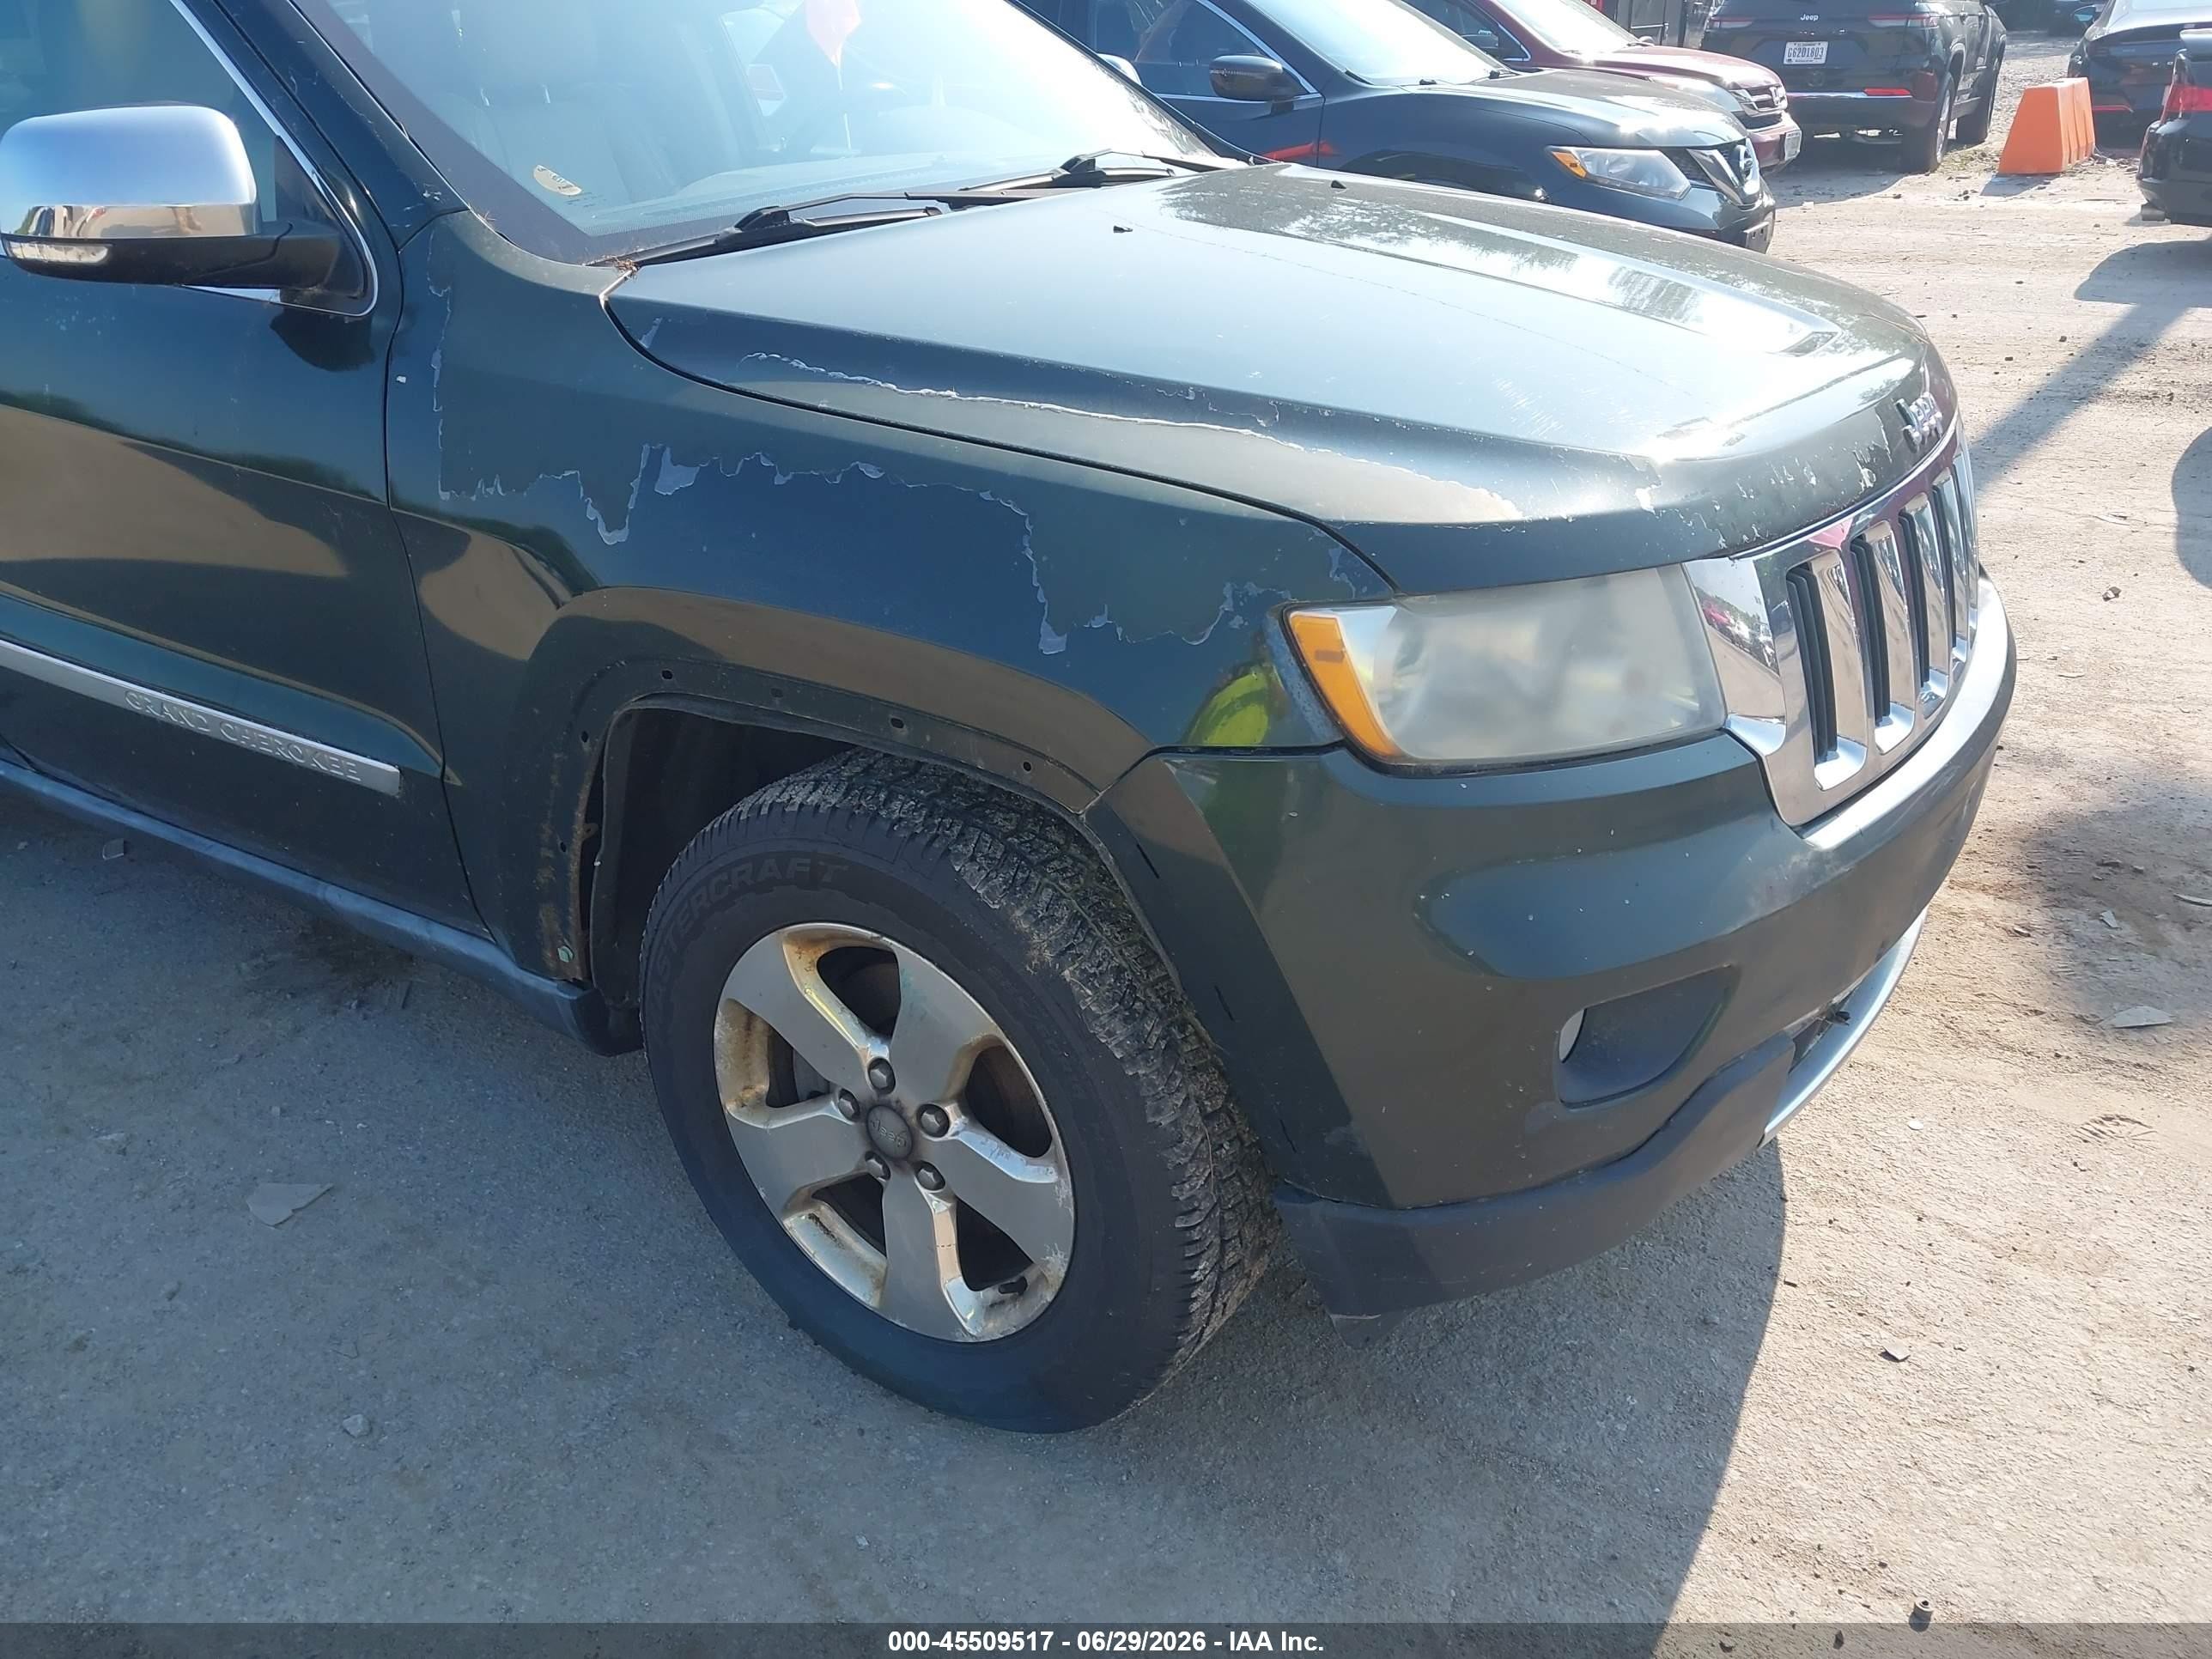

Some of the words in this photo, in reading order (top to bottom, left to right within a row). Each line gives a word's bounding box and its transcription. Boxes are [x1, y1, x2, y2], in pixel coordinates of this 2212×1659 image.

[1800, 13, 1819, 21] Jeep
[124, 690, 211, 732] GRAND
[219, 721, 362, 781] CHEROKEE
[870, 1119, 908, 1148] Jeep
